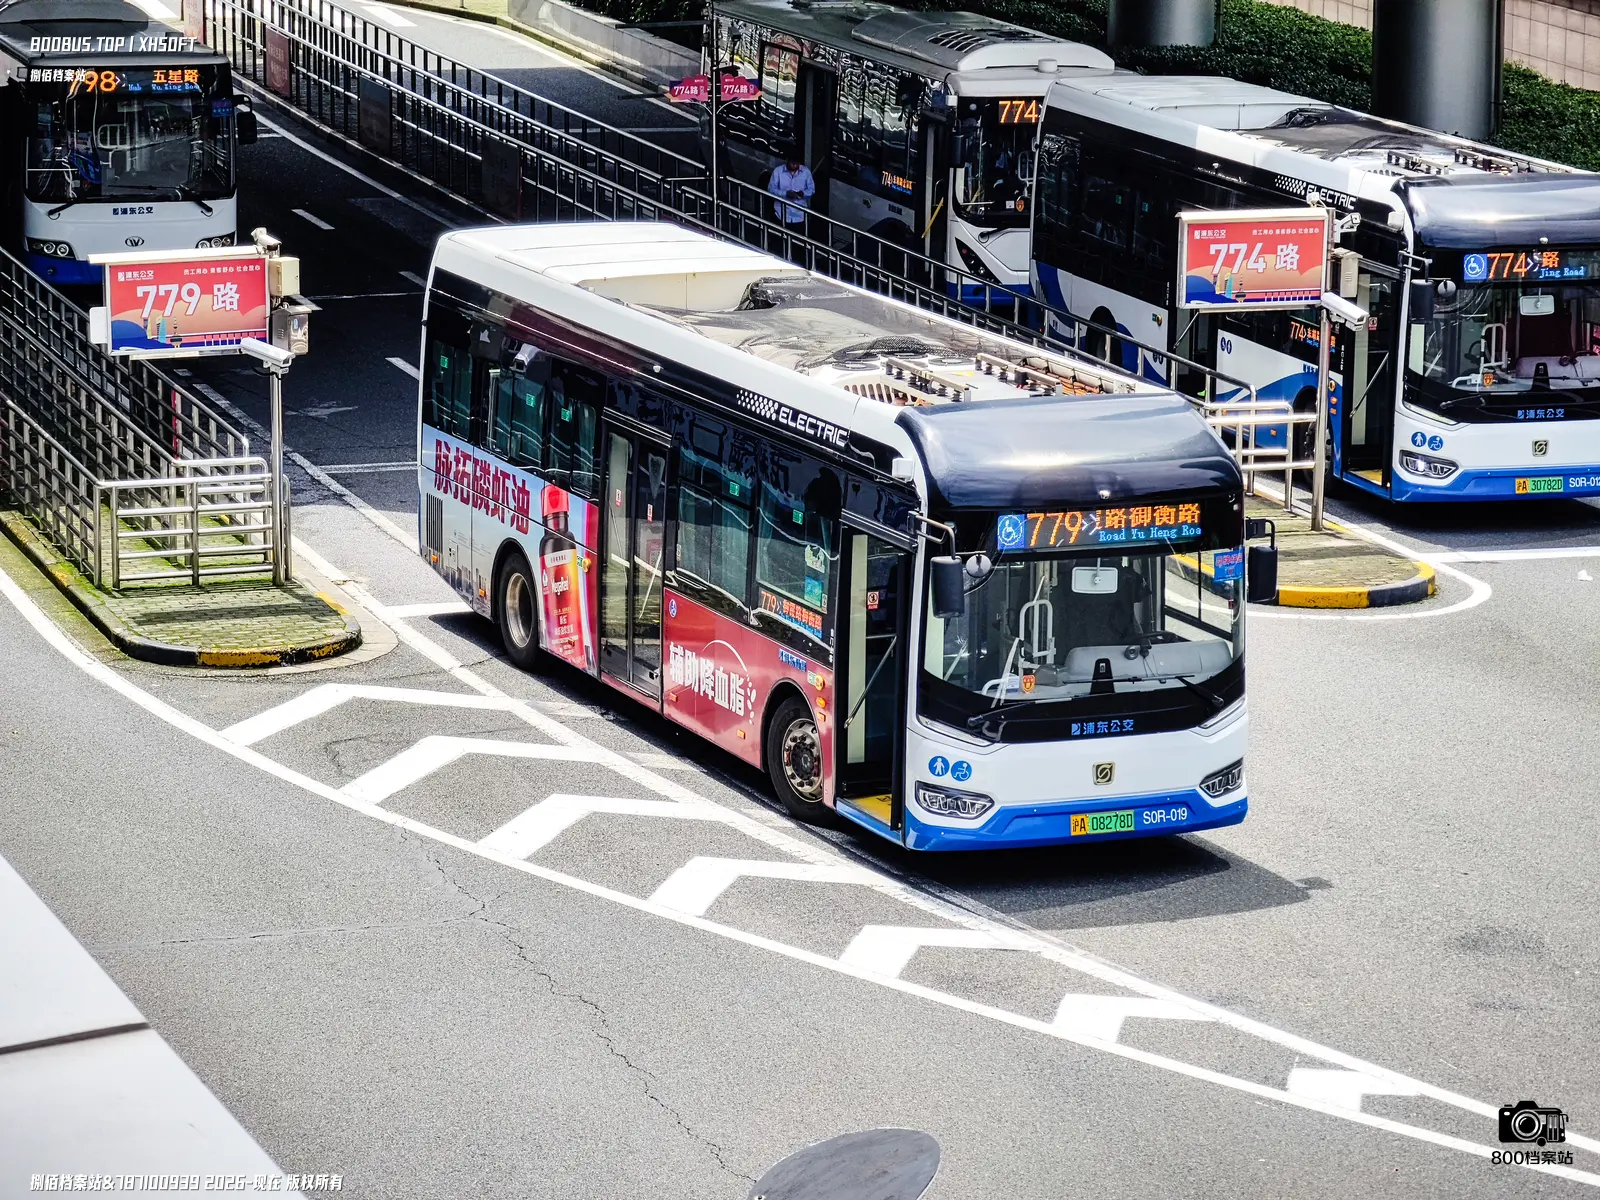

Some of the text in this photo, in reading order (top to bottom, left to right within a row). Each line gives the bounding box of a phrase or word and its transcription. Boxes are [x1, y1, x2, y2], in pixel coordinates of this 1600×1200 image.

[151, 69, 199, 83] 五星路
[673, 85, 699, 95] 774路
[723, 84, 748, 94] 774路
[998, 100, 1038, 123] 774
[120, 206, 154, 215] 浦东公交
[1209, 242, 1300, 275] 774 路
[1487, 251, 1559, 279] 774 路
[125, 270, 154, 279] 浦东公交
[1539, 266, 1585, 278] Jing Road
[136, 281, 240, 319] 779 路
[1290, 321, 1305, 341] 774
[1526, 408, 1565, 419] 浦东公交
[778, 406, 848, 447] ELECTRIC
[434, 438, 531, 535] 脉拓磷虾油
[1026, 511, 1083, 547] 779
[1099, 529, 1126, 541] Road
[1131, 528, 1146, 539] Yu
[1149, 526, 1177, 539] Heng
[760, 590, 777, 613] 779
[668, 641, 746, 717] 辅助降血脂
[1082, 719, 1134, 735] 浦东公交
